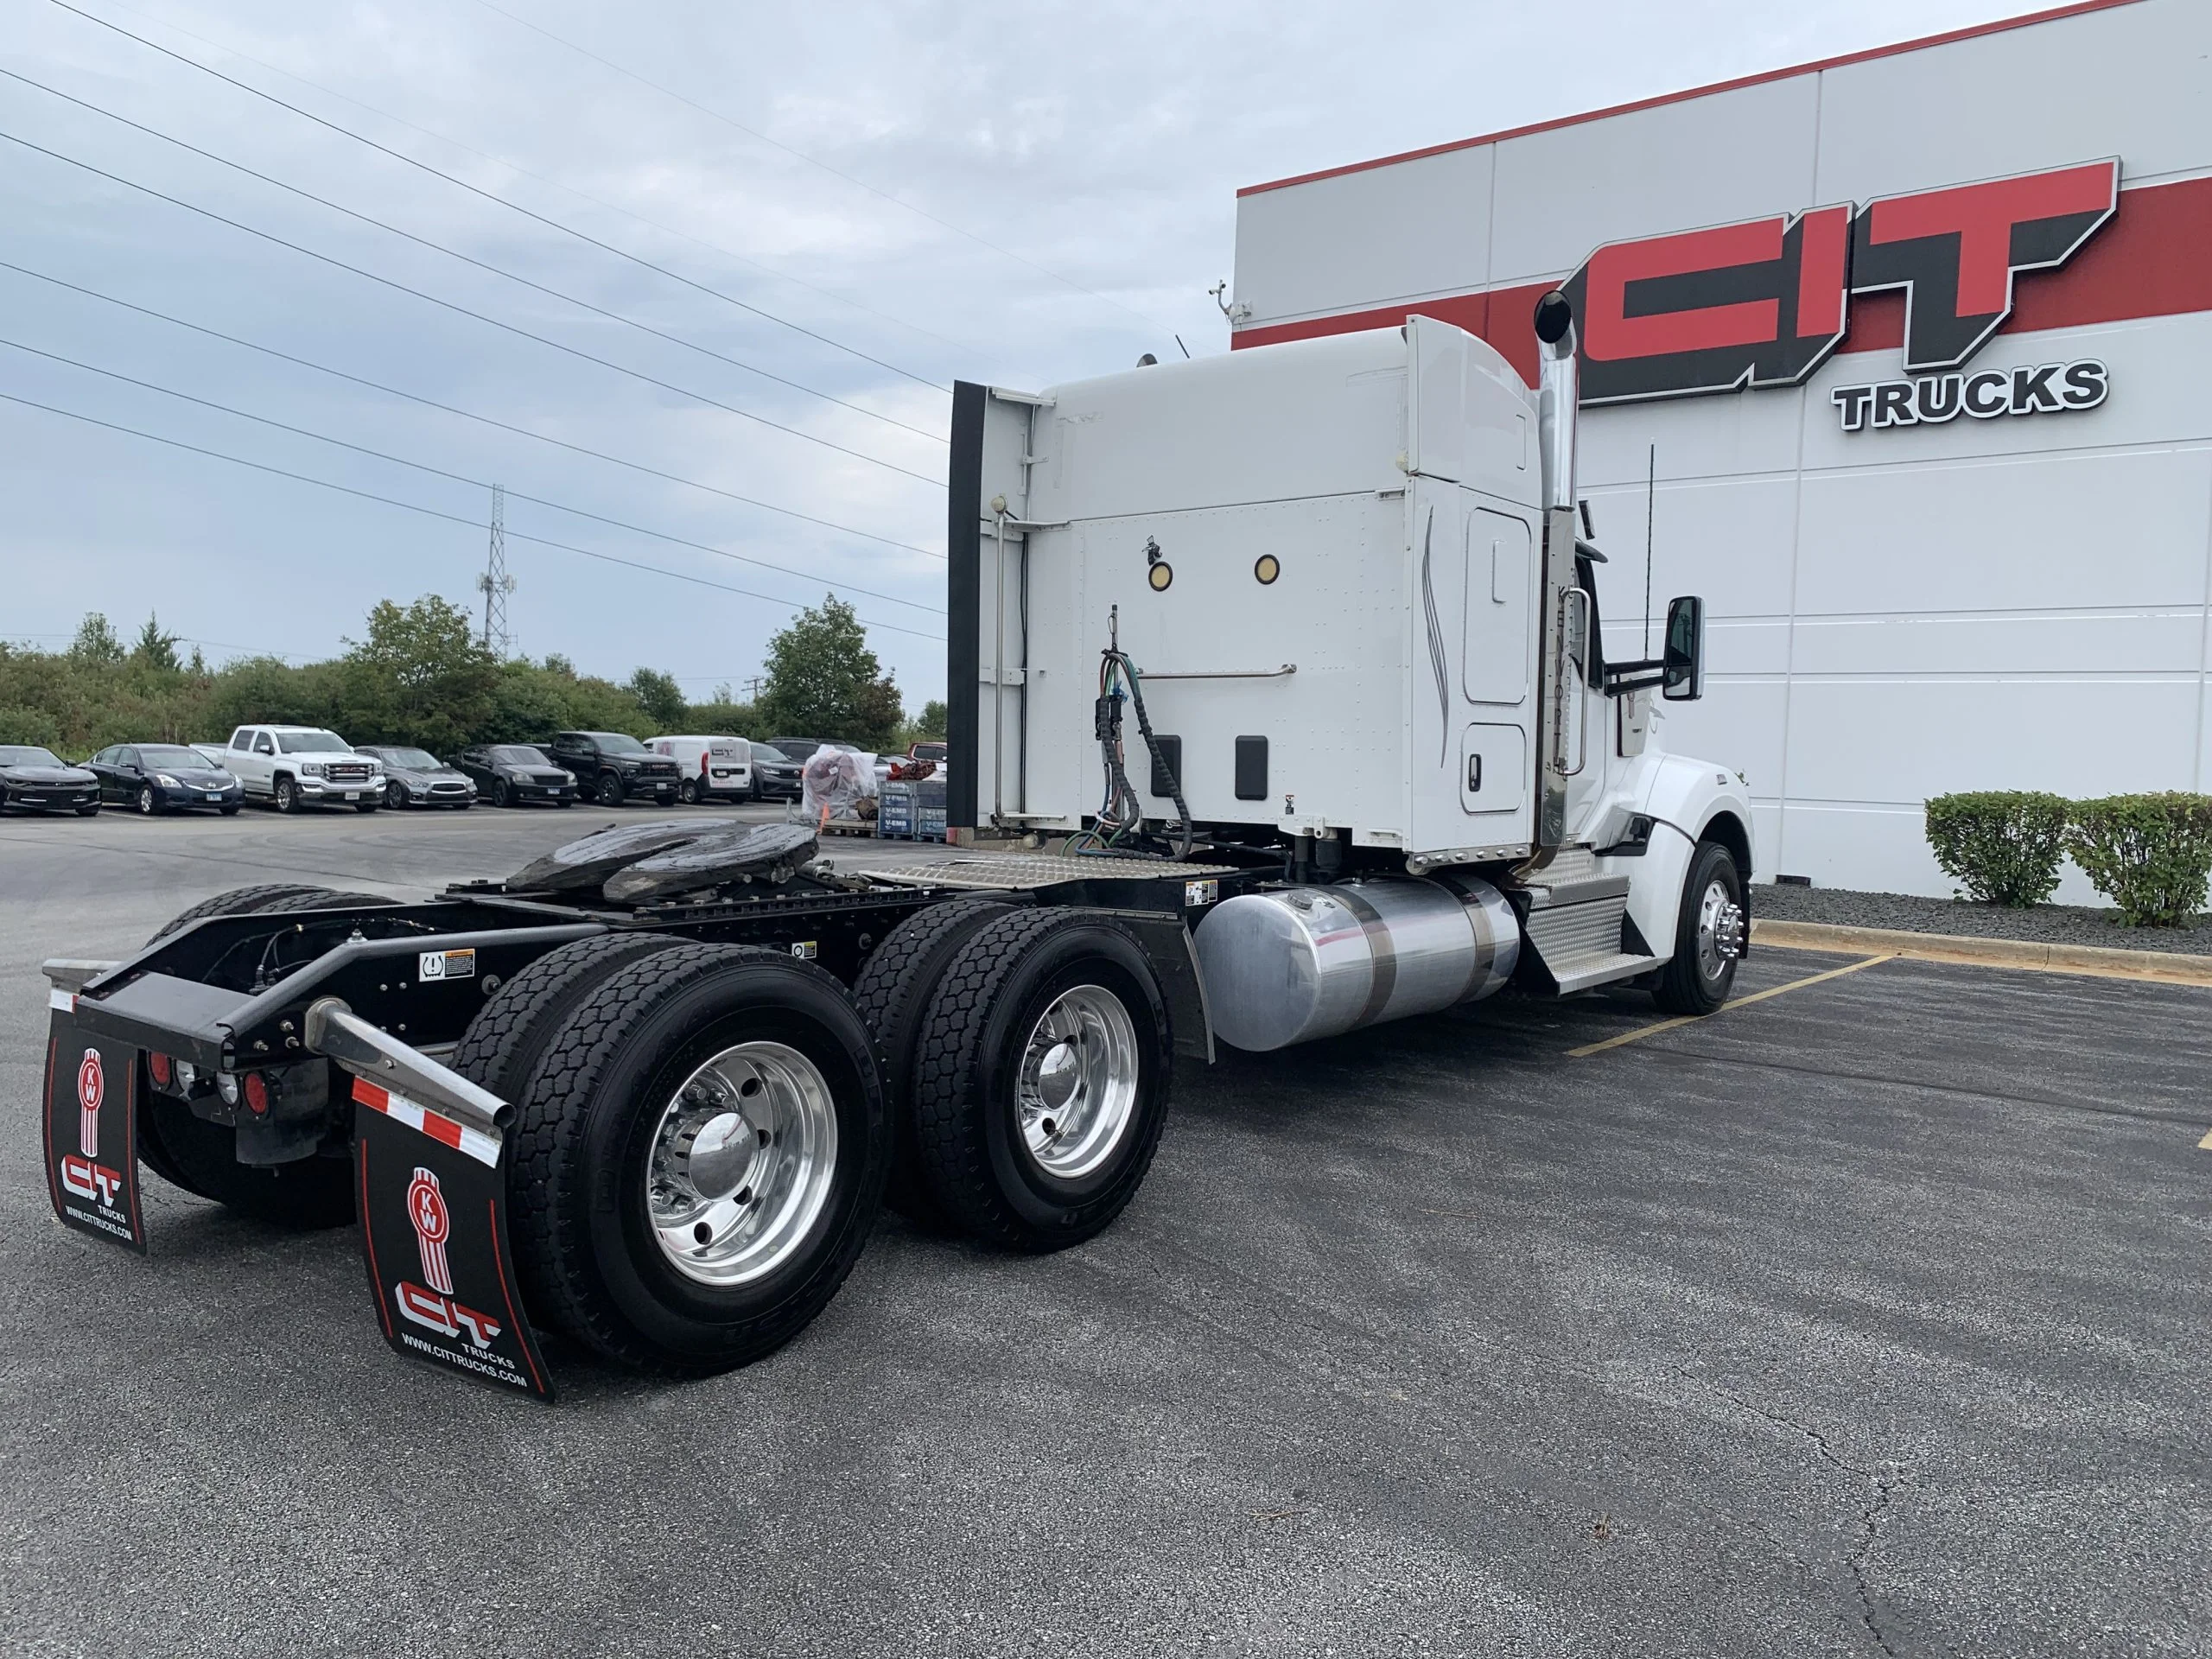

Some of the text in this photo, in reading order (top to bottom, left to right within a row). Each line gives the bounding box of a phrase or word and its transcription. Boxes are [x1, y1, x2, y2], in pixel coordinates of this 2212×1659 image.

[1580, 156, 2120, 406] CIT
[1831, 359, 2107, 429] TRUCKS
[61, 1154, 121, 1207] CIT
[66, 1205, 133, 1241] WWW.CITTRUCKS.COM
[98, 1205, 126, 1224] TRUCKS
[395, 1281, 501, 1350] CIT
[402, 1332, 527, 1388] WWW.CITTRUCKS.COM
[461, 1343, 515, 1370] TRUCKS
